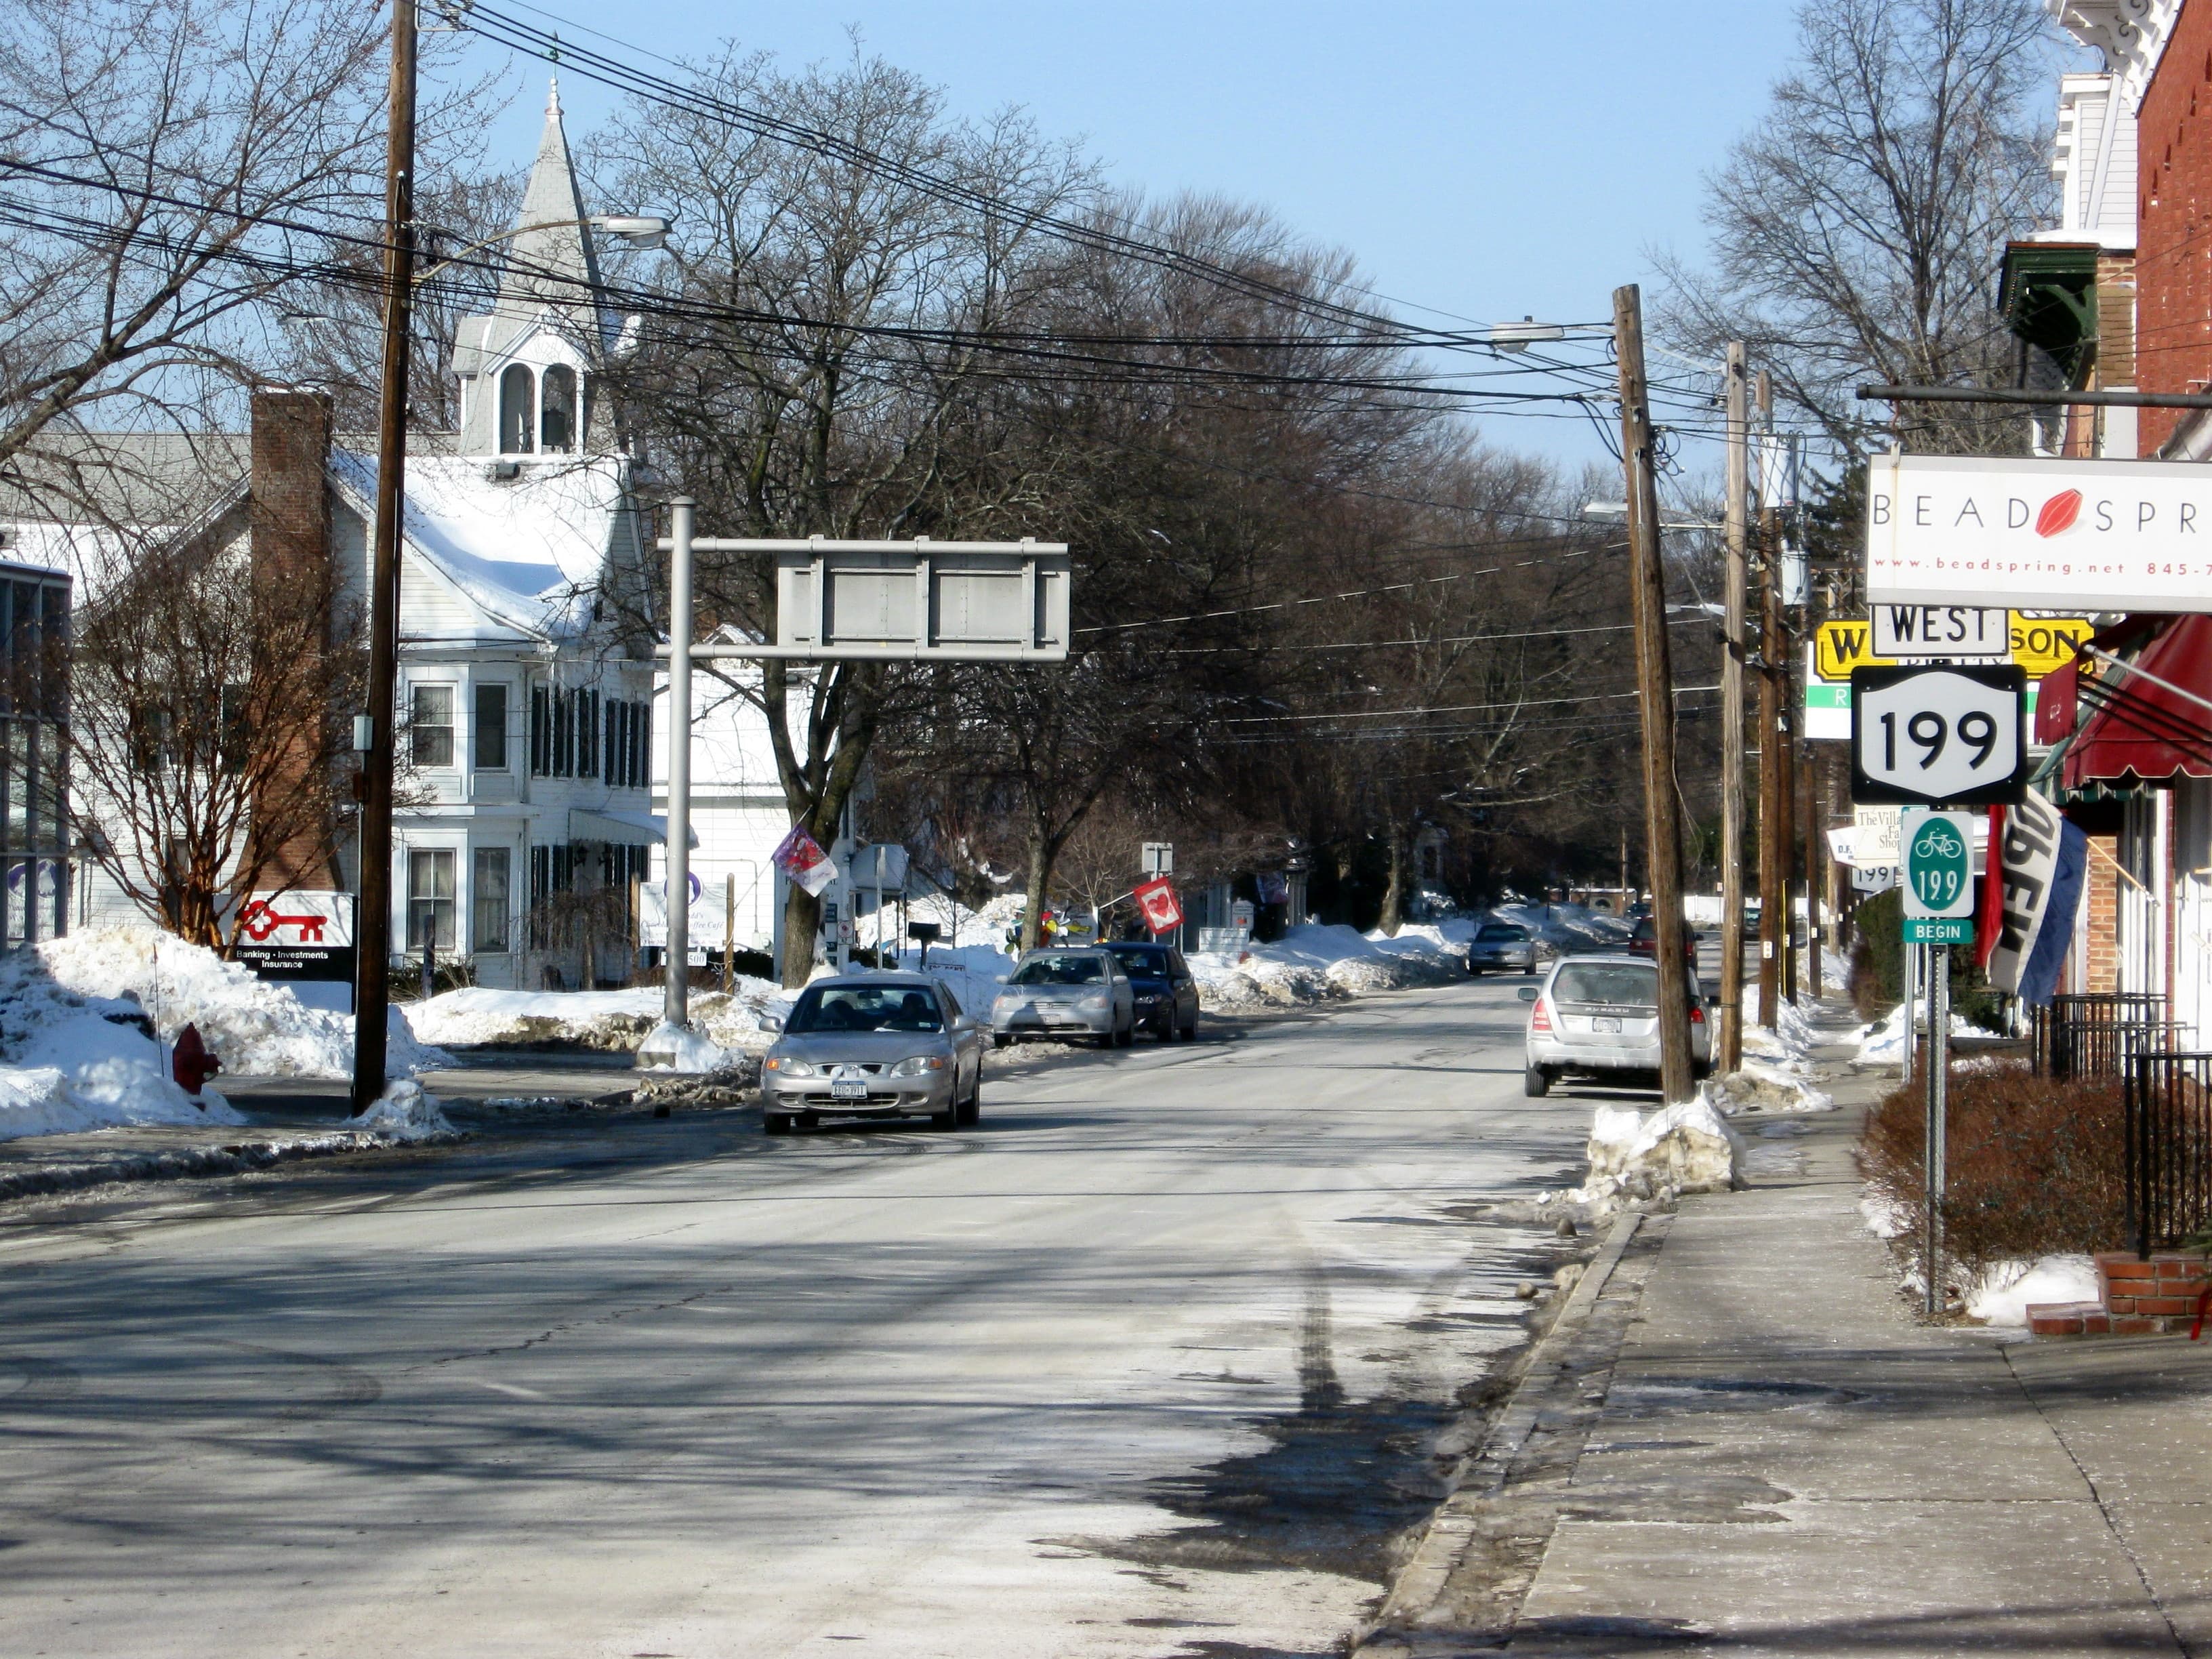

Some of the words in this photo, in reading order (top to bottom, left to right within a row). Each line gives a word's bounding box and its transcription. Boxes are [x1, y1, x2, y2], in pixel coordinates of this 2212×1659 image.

[1873, 494, 2030, 529] BEAD
[1875, 557, 2125, 575] www.beadspring.net
[1891, 607, 1990, 642] WEST
[1880, 710, 1998, 771] 199
[1858, 812, 1877, 825] The
[1858, 867, 1888, 882] 199
[1919, 871, 1958, 901] 199
[1916, 925, 1961, 939] BEGIN
[237, 950, 270, 960] Banking
[278, 950, 329, 960] Investments
[262, 960, 303, 968] Insurance
